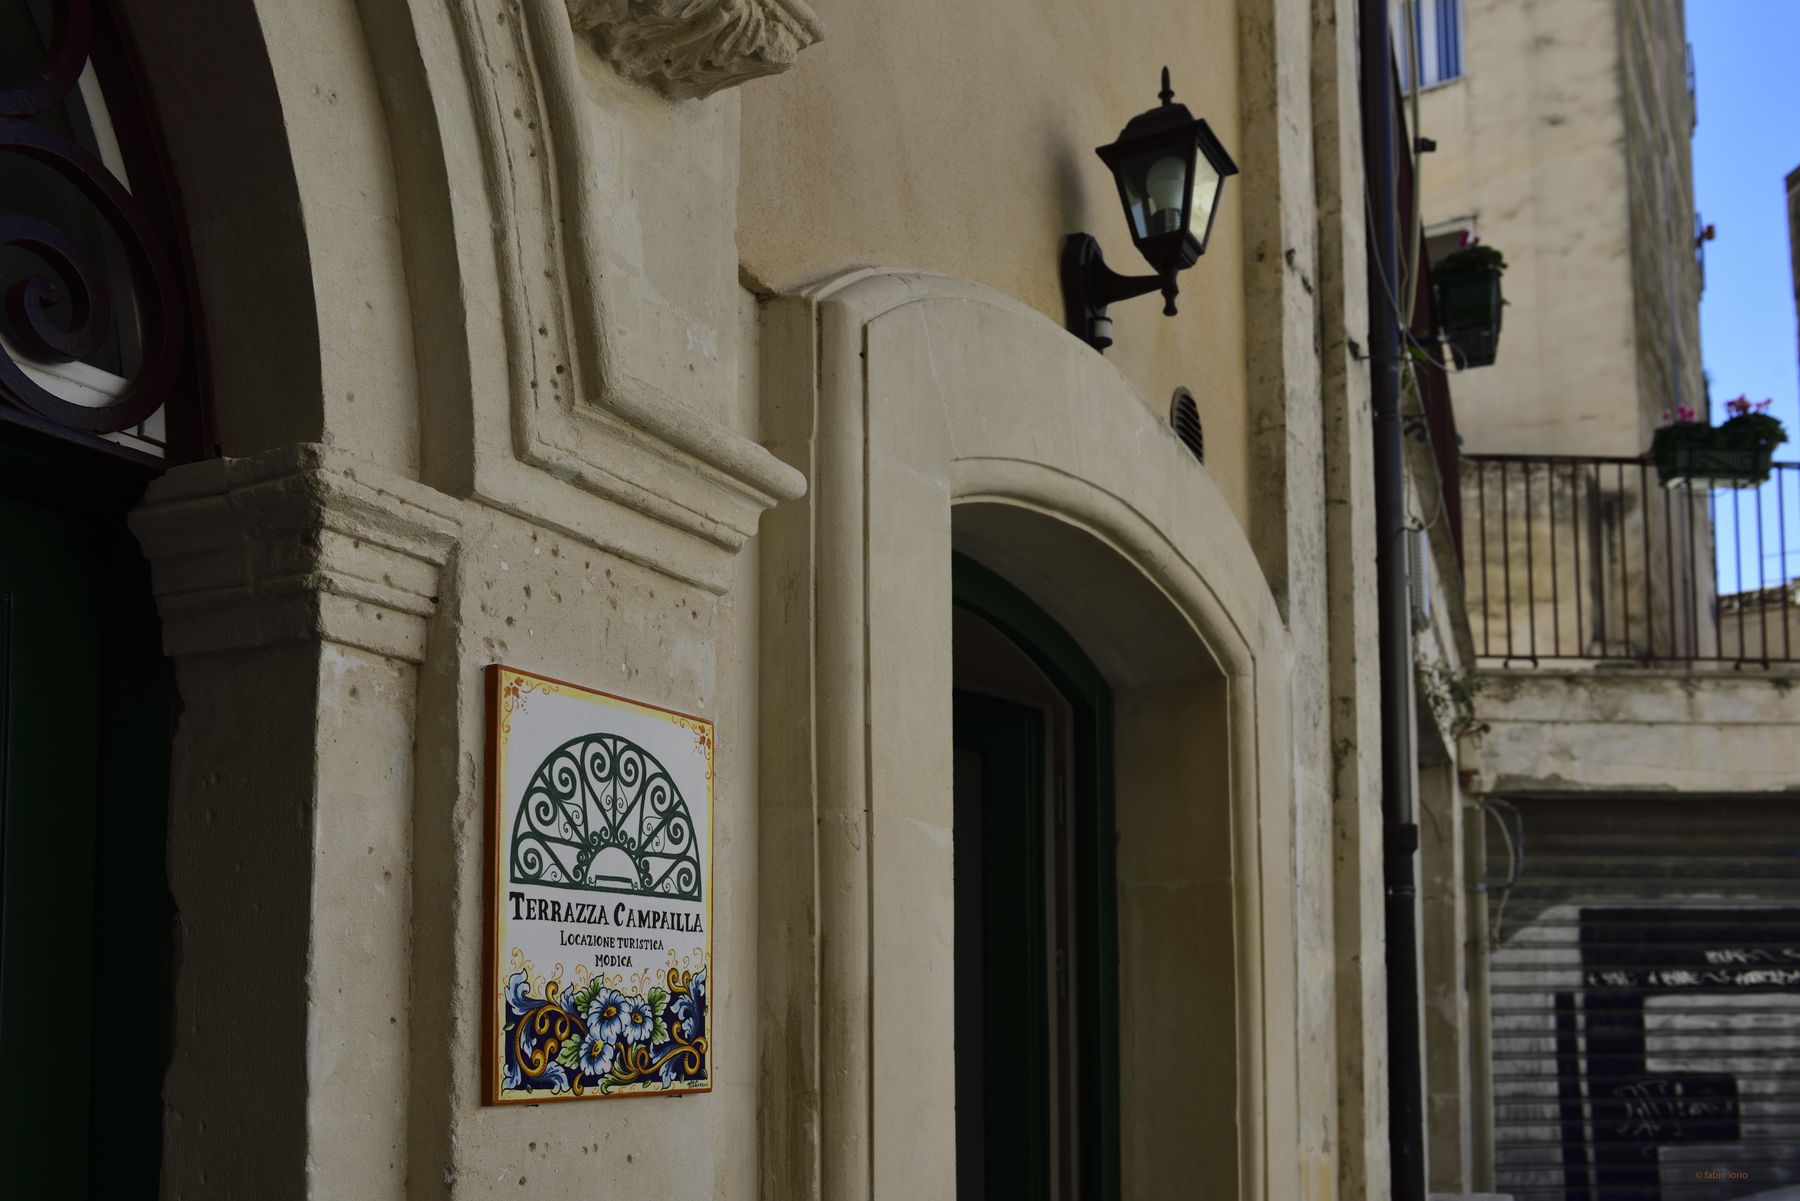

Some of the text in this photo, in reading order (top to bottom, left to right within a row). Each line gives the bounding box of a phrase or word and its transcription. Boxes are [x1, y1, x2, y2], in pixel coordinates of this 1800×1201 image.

[509, 891, 703, 932] TERRAZZA CAMPAILLA
[560, 930, 664, 950] LOCAZIONE TURISTICA
[595, 954, 632, 967] MODICA
